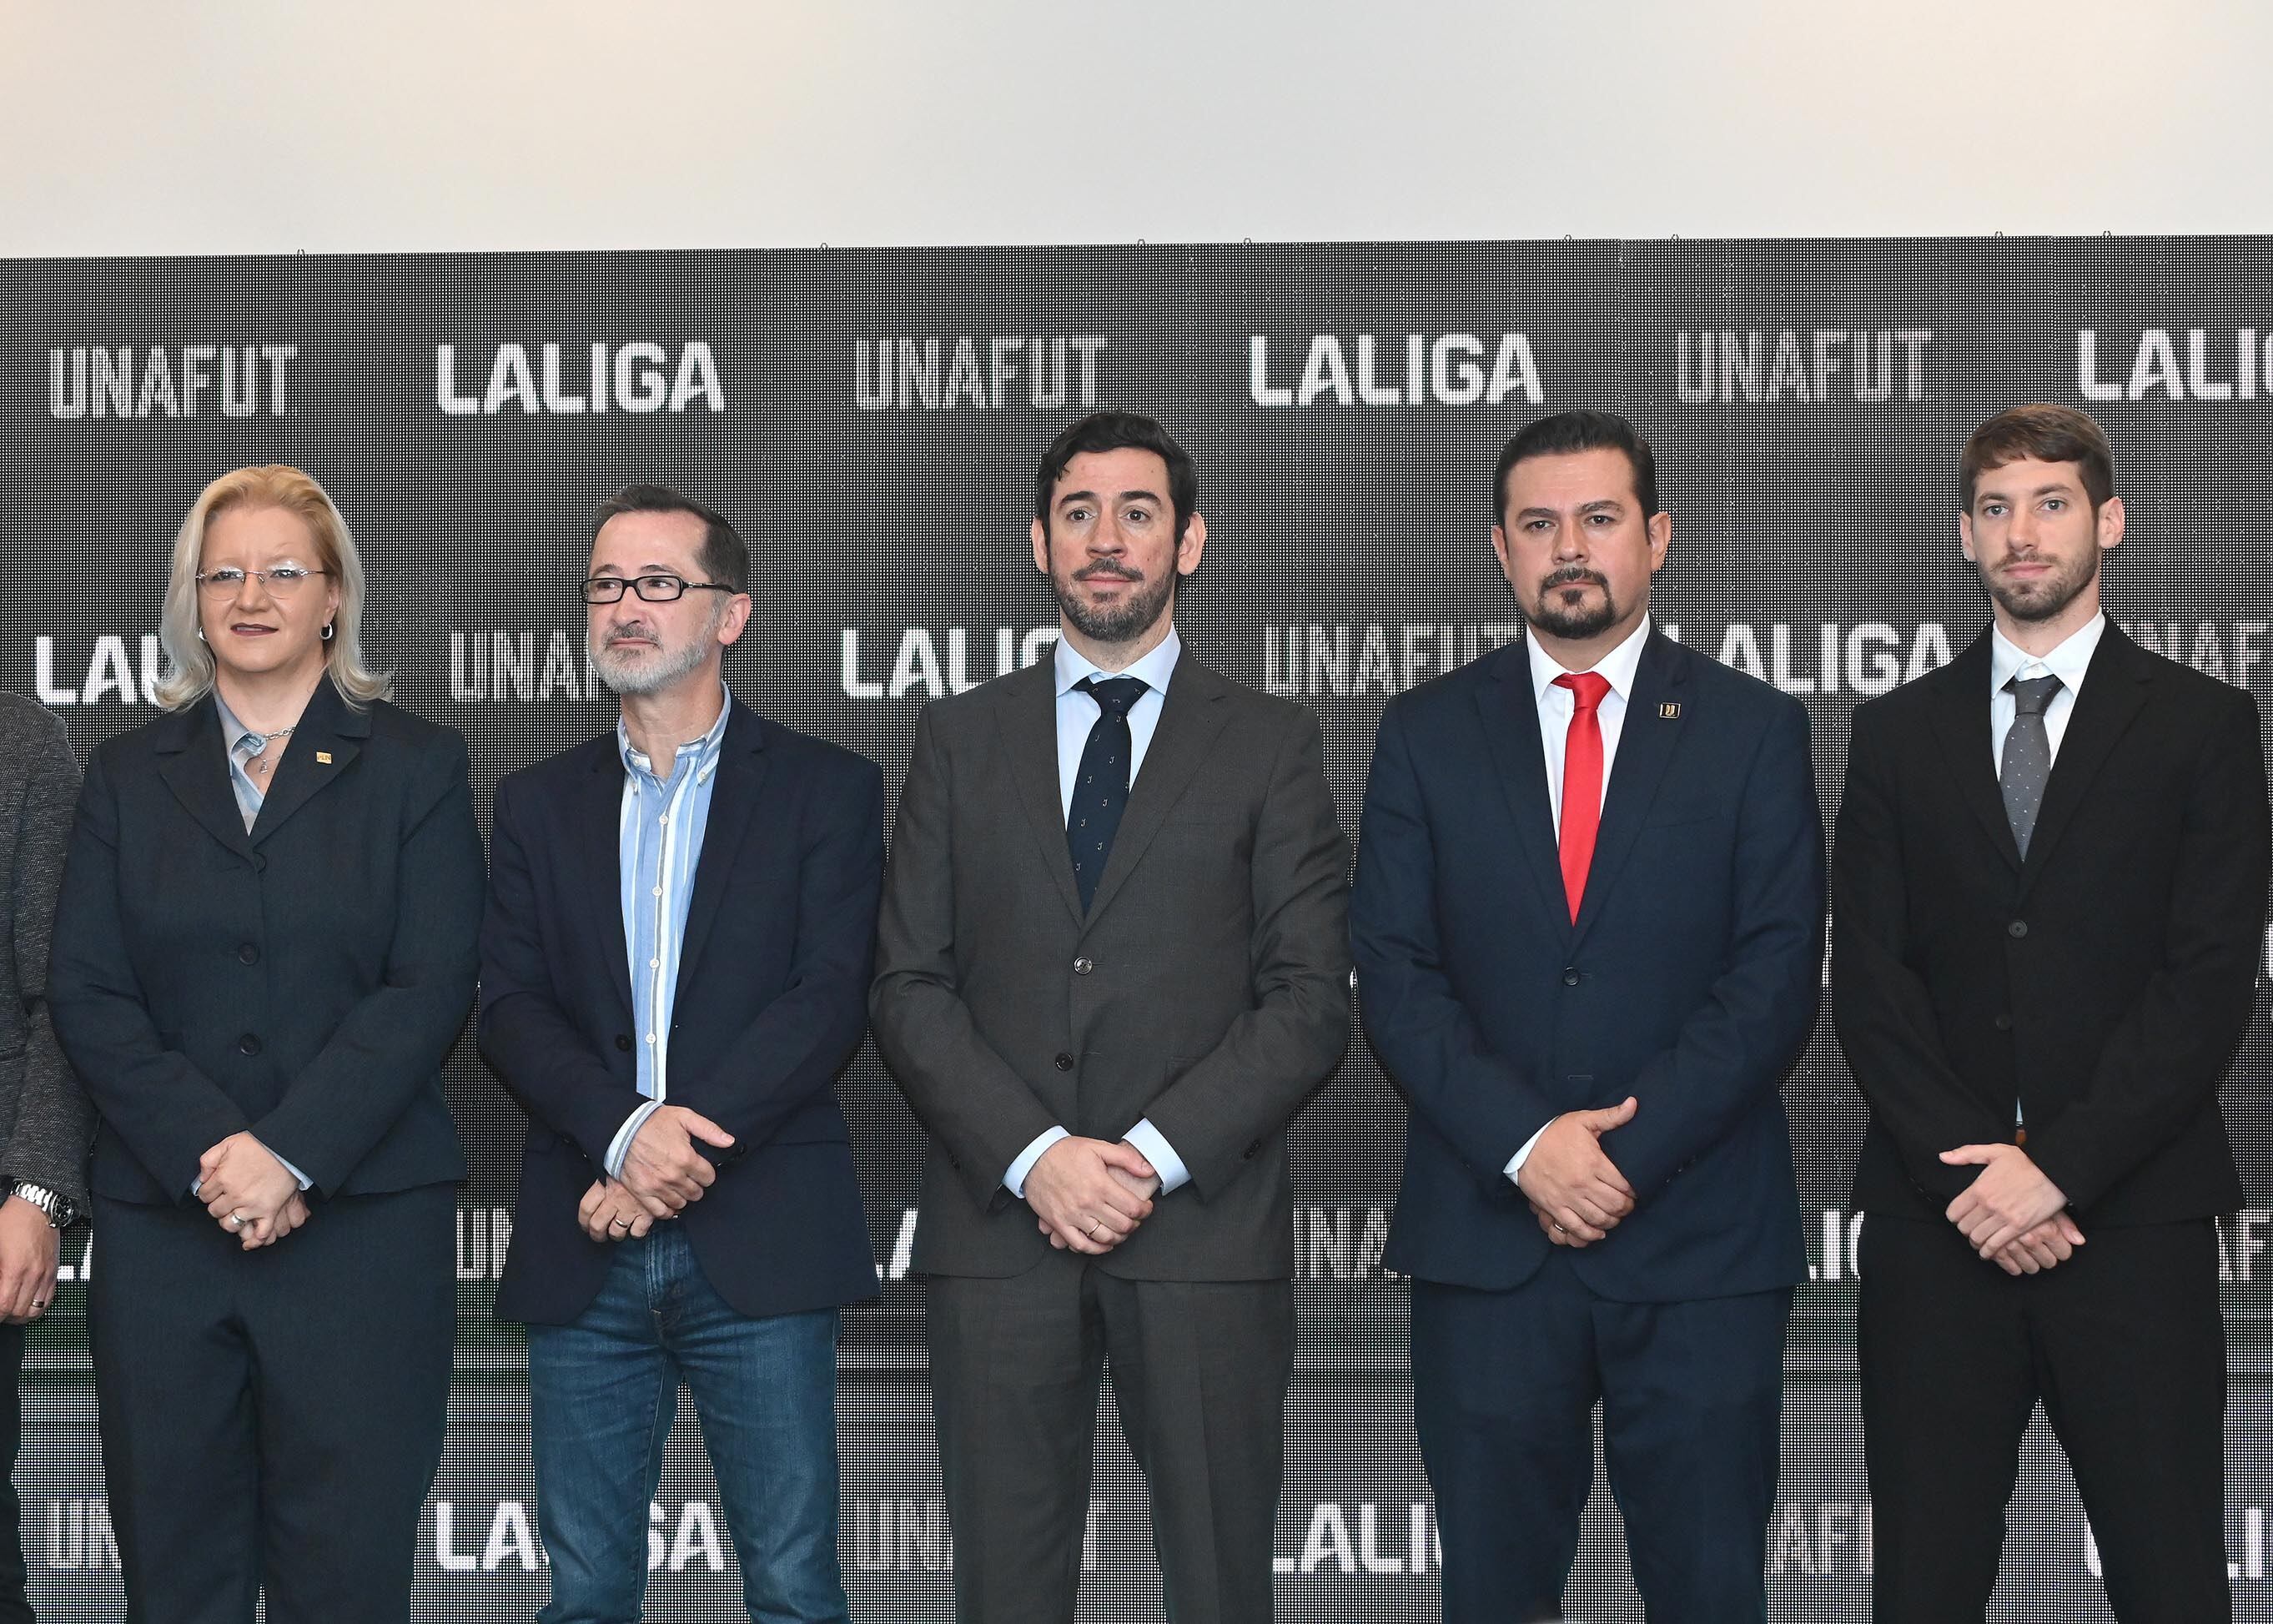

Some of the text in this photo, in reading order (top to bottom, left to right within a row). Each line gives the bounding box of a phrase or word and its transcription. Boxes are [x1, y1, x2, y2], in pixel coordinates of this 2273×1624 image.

[50, 344, 298, 419] UNAFUT
[437, 342, 725, 415] LALIGA
[856, 335, 1107, 410] UNAFUT
[1250, 333, 1544, 407] LALIGA
[1677, 329, 1932, 404] UNAFUT
[2078, 328, 2273, 401] LALI
[1667, 624, 1952, 695] ALIGA
